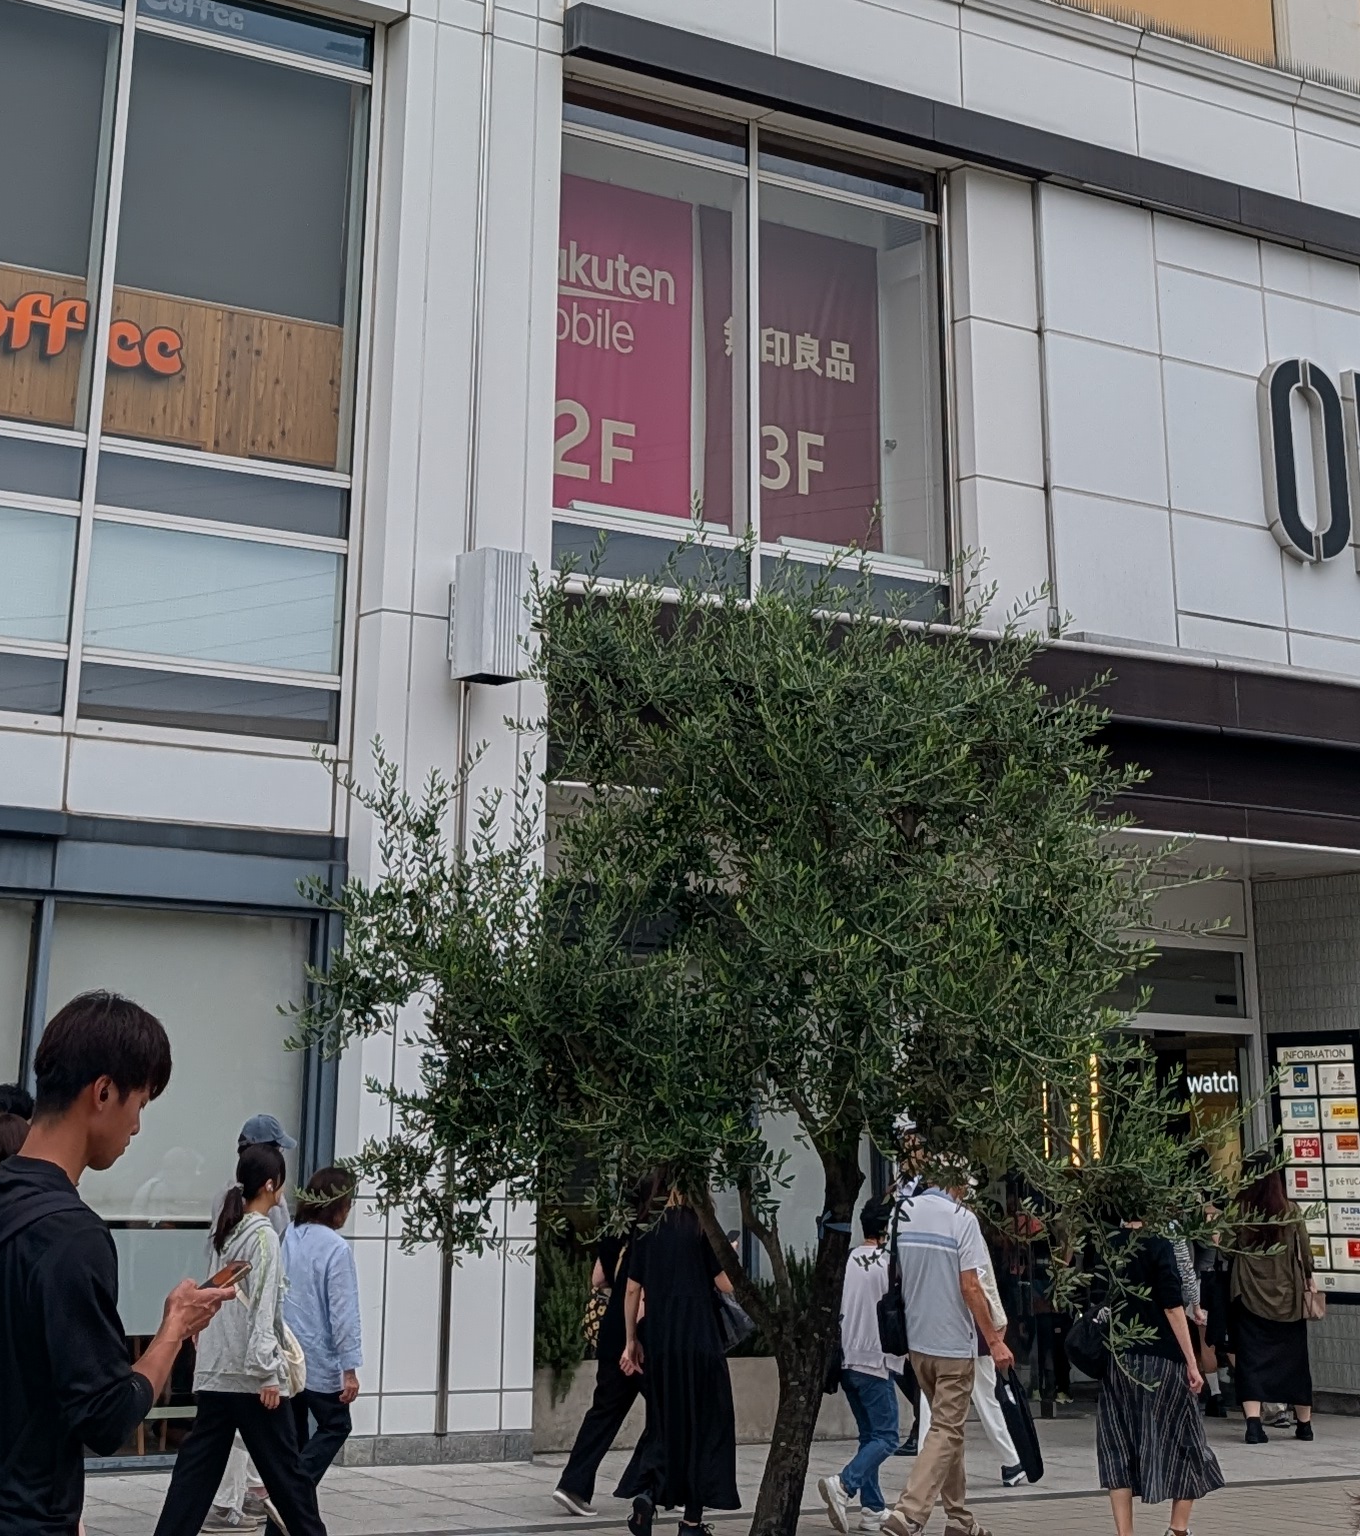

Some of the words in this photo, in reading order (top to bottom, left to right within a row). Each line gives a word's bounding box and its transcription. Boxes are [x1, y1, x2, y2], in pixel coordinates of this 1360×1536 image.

[557, 240, 675, 305] kuten
[556, 302, 634, 354] obile
[554, 398, 636, 485] 2F
[760, 425, 824, 496] 3F
[1283, 1048, 1346, 1060] INFORMATION
